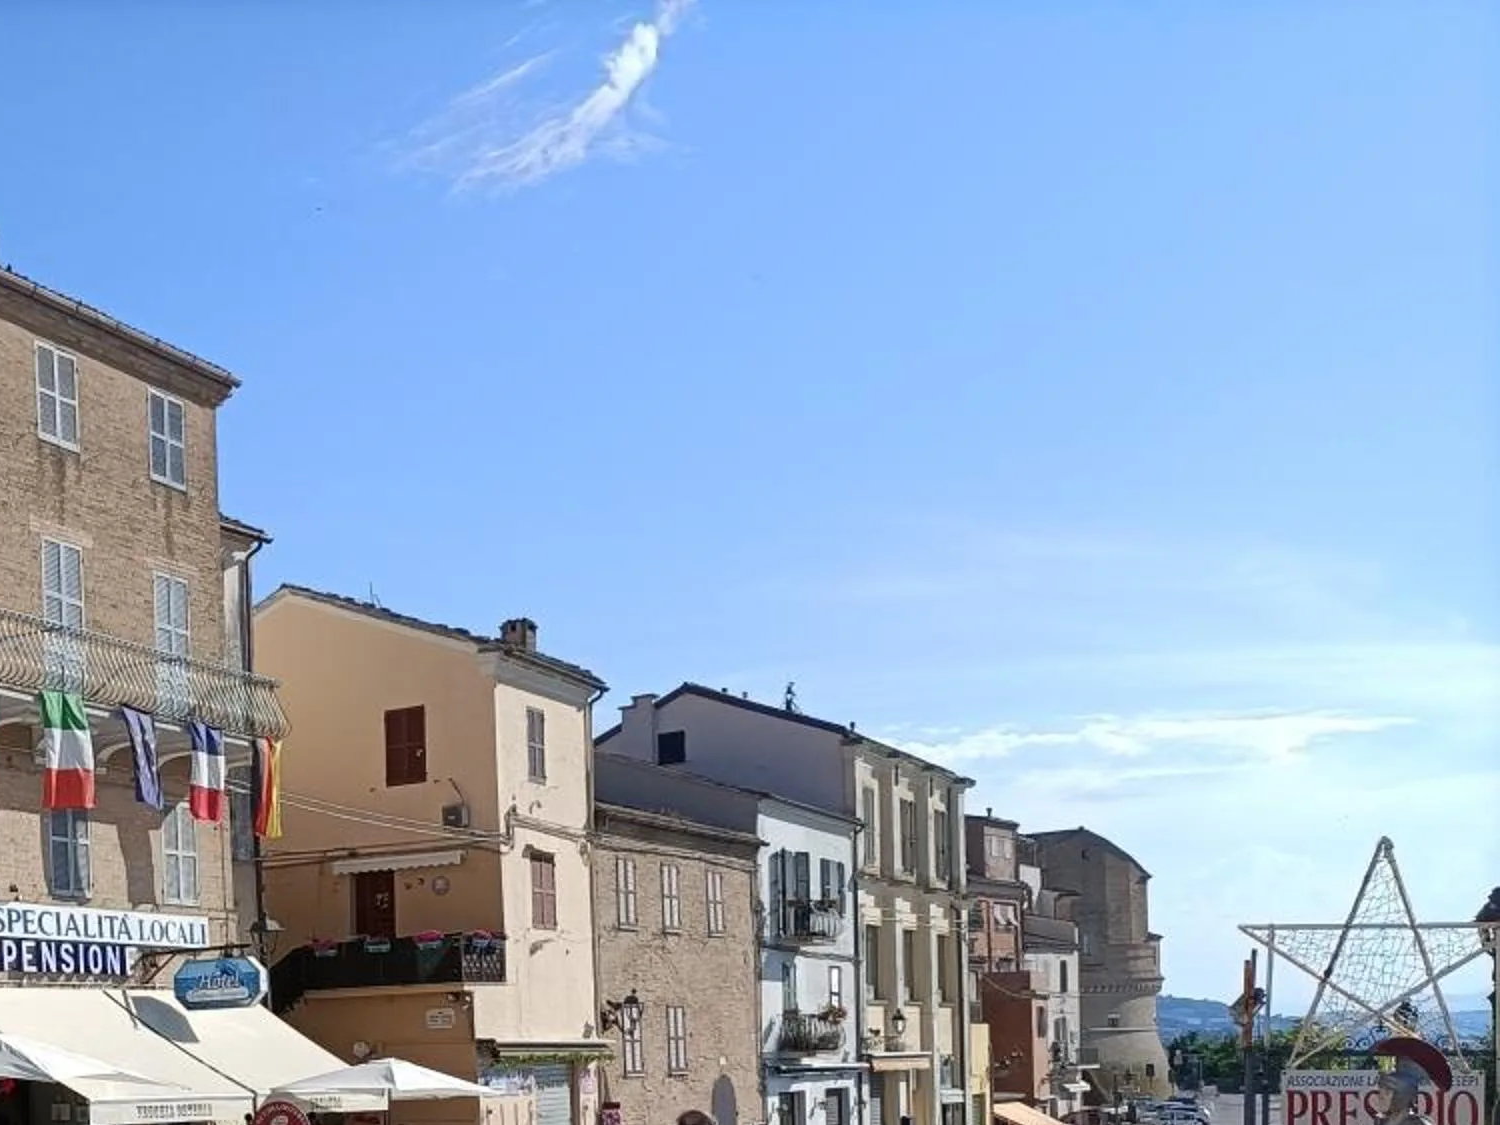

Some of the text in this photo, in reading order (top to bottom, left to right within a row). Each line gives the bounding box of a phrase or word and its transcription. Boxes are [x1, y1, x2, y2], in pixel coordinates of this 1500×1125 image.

[138, 918, 210, 946] LOCALI
[1, 938, 137, 977] PENSIONE
[1286, 1074, 1368, 1087] ASSOCIAZIONE
